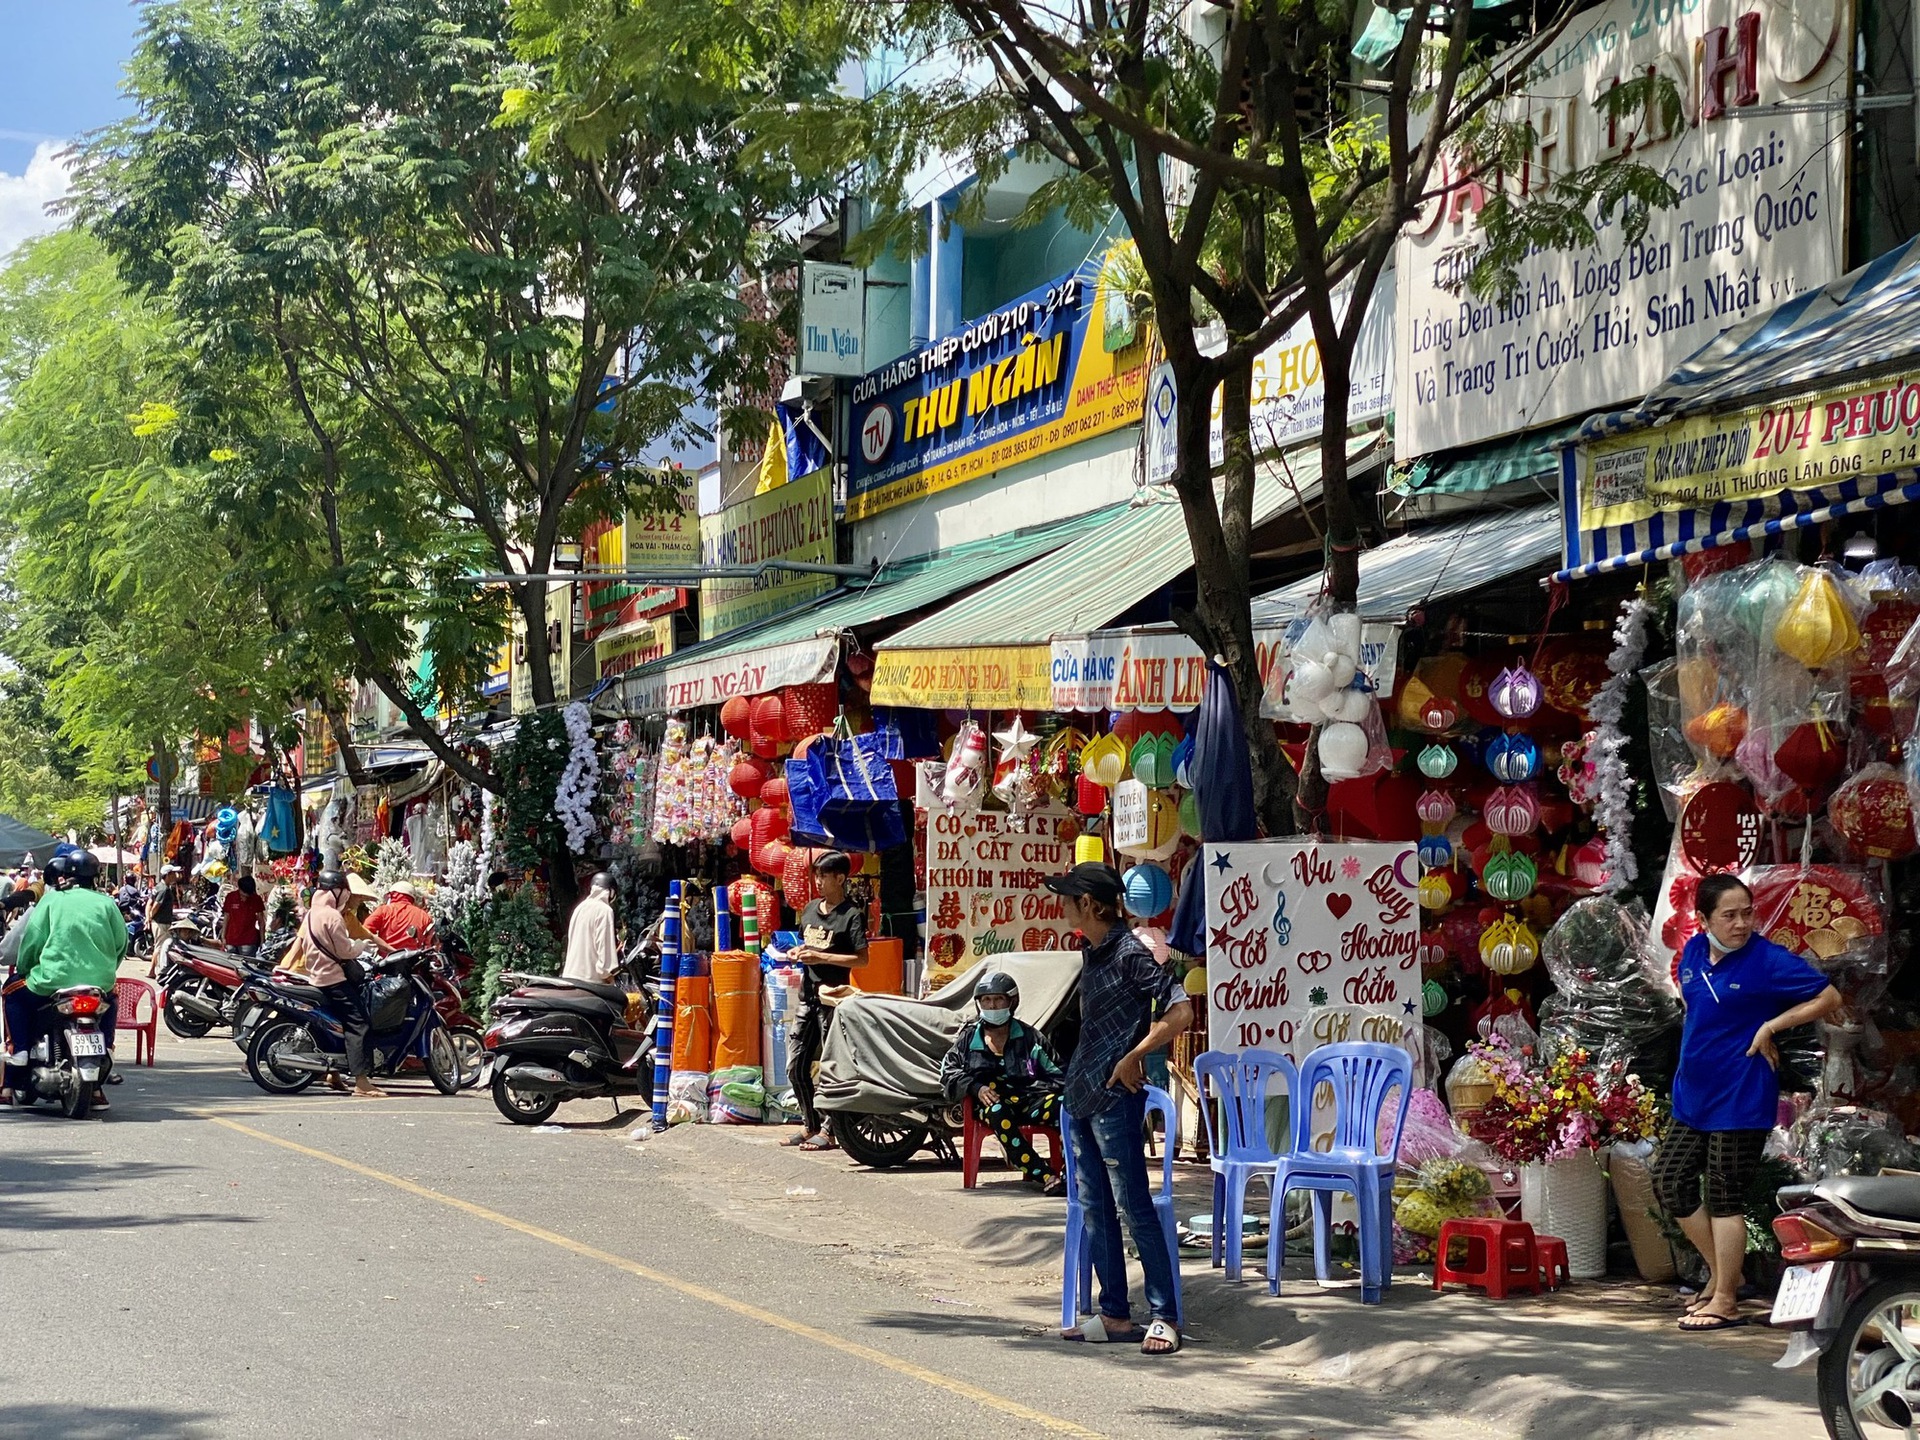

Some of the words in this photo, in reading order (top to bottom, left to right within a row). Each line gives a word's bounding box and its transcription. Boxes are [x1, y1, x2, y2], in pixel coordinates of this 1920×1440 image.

[1717, 130, 1785, 187] Loại:
[1413, 308, 1453, 354] Lồng
[1536, 271, 1566, 312] An,
[1573, 246, 1622, 299] Lồng
[1628, 235, 1671, 281] Đèn
[1679, 215, 1745, 263] Trung
[1754, 171, 1818, 242] Quốc
[805, 325, 828, 353] Thu
[831, 327, 859, 361] Ngân
[852, 374, 878, 405] CỬA
[880, 356, 917, 392] HÀNG
[919, 336, 959, 374] THIỆP
[961, 313, 999, 354] CƯỚI
[1000, 302, 1029, 336] 210
[1045, 278, 1076, 314] 212
[1414, 366, 1437, 406] Và
[1443, 359, 1496, 398] Trang
[1502, 336, 1531, 381] Trí
[1645, 284, 1695, 338] Sinh
[1703, 265, 1761, 319] Nhật
[902, 377, 961, 444] THU
[966, 331, 1065, 418] NGÂN
[1077, 384, 1096, 407] DANH
[996, 422, 1009, 436] HOA
[1062, 422, 1078, 439] 0907
[1092, 412, 1106, 428] 271
[1125, 398, 1140, 415] 999
[1752, 400, 1815, 460] 204
[1732, 467, 1788, 494] THƯỢNG
[1794, 459, 1823, 482] LÃN
[1829, 454, 1862, 476] ÔNG
[643, 514, 682, 533] 214
[807, 493, 829, 543] 214
[630, 542, 644, 550] HOA
[753, 571, 770, 593] HOA
[669, 676, 705, 707] THU
[711, 662, 768, 700] NGÂN
[911, 664, 937, 690] 208
[937, 655, 979, 692] HỒNG
[982, 663, 1012, 692] HOA
[1052, 649, 1079, 682] CỬA
[1082, 651, 1115, 681] HÀNG
[1114, 645, 1166, 706] ÁNH
[1290, 847, 1336, 888] Vu
[1362, 863, 1416, 925] Quy
[1237, 1020, 1263, 1047] 10
